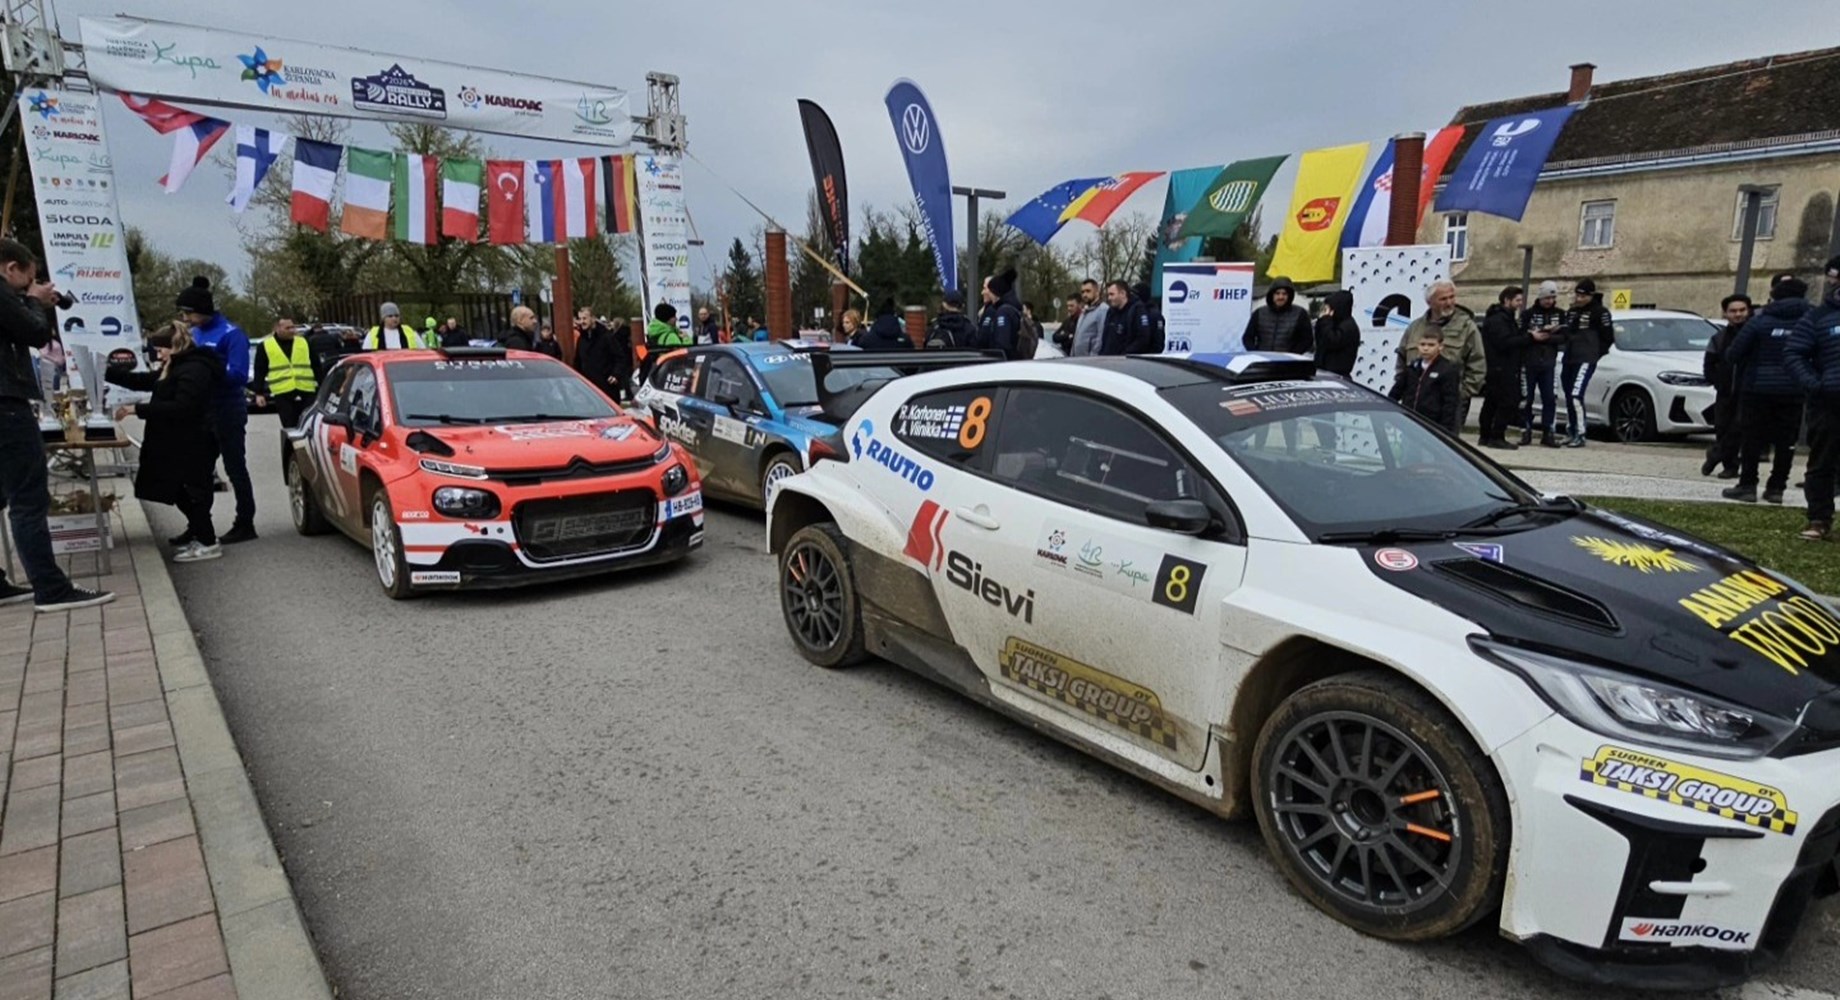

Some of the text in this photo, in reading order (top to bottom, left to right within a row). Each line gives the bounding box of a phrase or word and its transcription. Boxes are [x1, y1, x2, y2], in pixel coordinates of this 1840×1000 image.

[151, 40, 221, 79] Kupa
[387, 91, 431, 108] RALLY
[484, 94, 543, 112] KARLOVAC
[53, 130, 101, 142] KARLOVAC
[36, 147, 82, 170] Kupa
[50, 240, 87, 250] Leasing
[53, 232, 90, 241] IMPULS
[76, 270, 122, 279] RIJEKE
[81, 291, 124, 304] timing
[1225, 288, 1248, 300] HEP
[907, 404, 947, 421] Korhonen
[959, 396, 992, 449] 8
[866, 438, 935, 492] RAUTIO
[1037, 549, 1067, 564] KARLOVAC
[1117, 559, 1149, 587] Kupa
[946, 549, 1035, 625] Sievi
[1165, 564, 1190, 602] 8
[1678, 569, 1789, 629] ANAIKA
[1014, 642, 1057, 665] SUOMEN
[1012, 652, 1153, 724] TAKSI GROUP
[1134, 690, 1153, 701] OY
[1608, 749, 1667, 769] SUOMEN
[1600, 758, 1777, 817] TAKSI GROUP
[1758, 787, 1777, 797] OY
